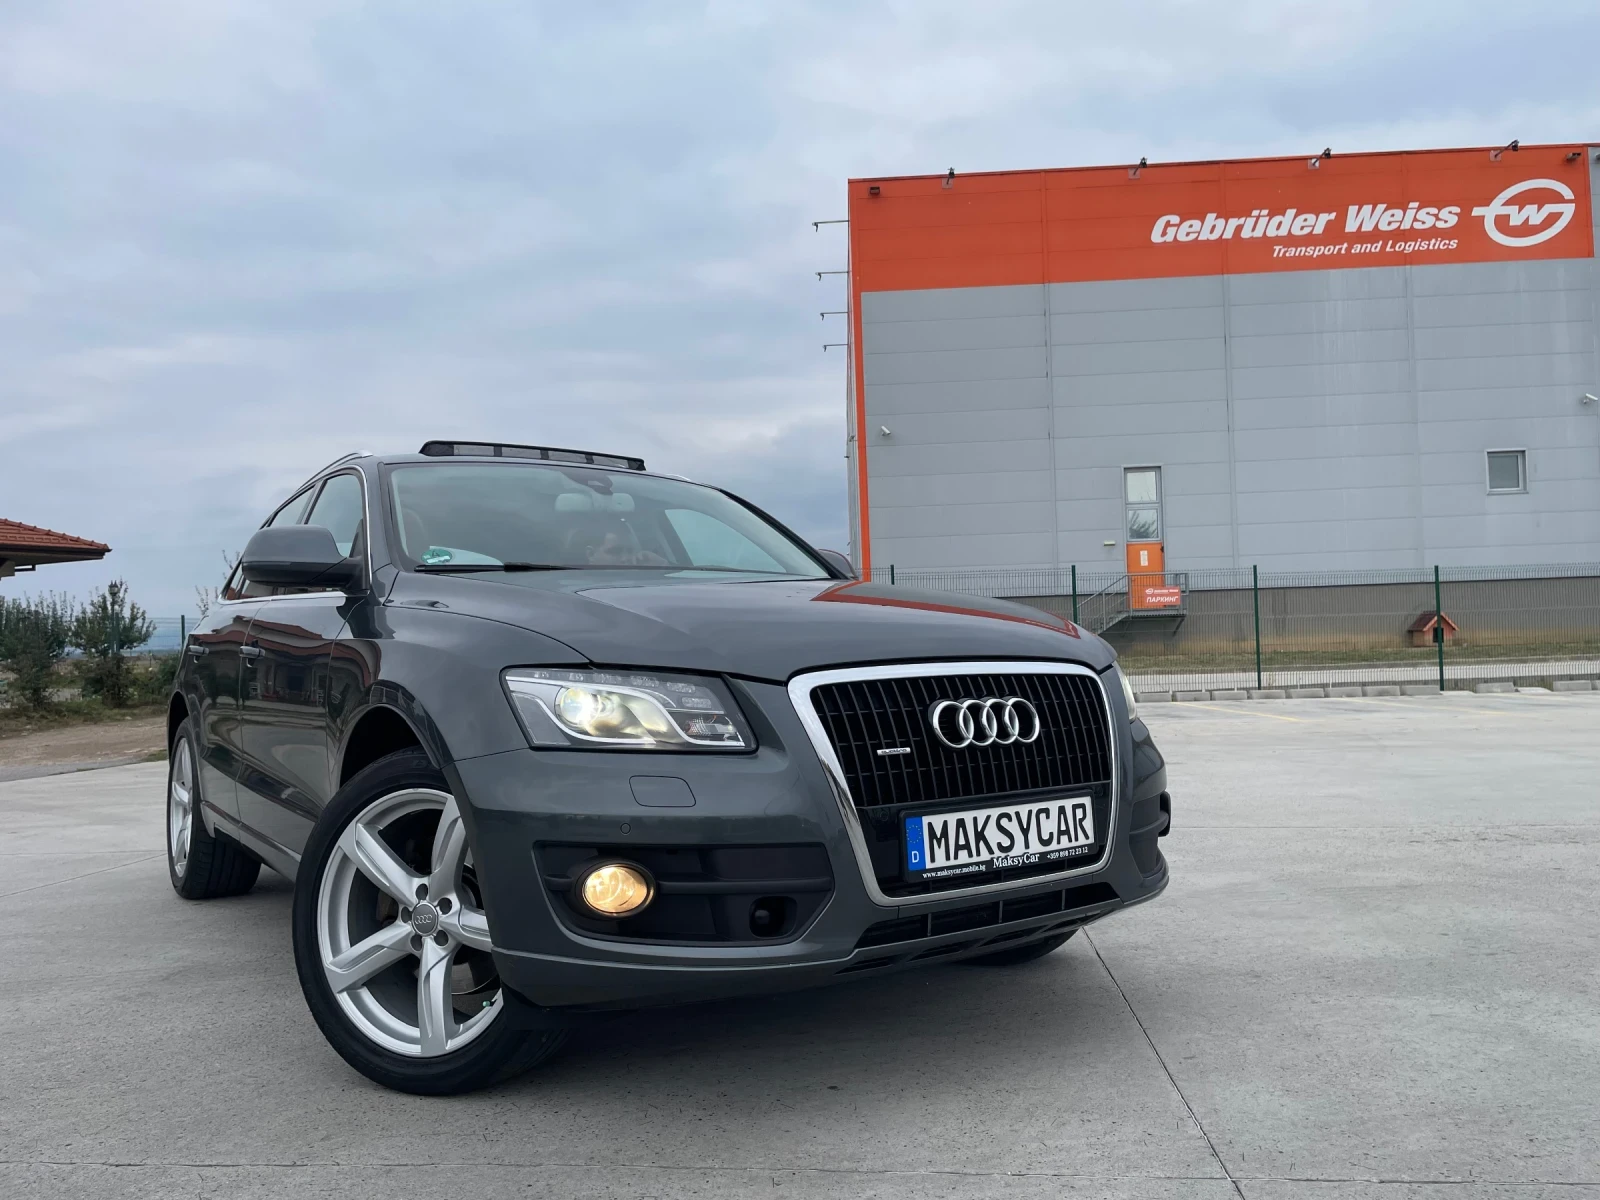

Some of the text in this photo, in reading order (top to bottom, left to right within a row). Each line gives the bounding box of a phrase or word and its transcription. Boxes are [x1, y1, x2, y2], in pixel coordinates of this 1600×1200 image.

[1150, 202, 1460, 243] Gebrüder Weiss
[1272, 237, 1459, 258] Transport and Logistics
[1147, 595, 1179, 603] ПАРКИНГ
[911, 803, 1090, 864] D MAKSYCAR
[922, 864, 986, 878] www.maksycar.mobile.bg
[993, 852, 1040, 869] MaksyCar
